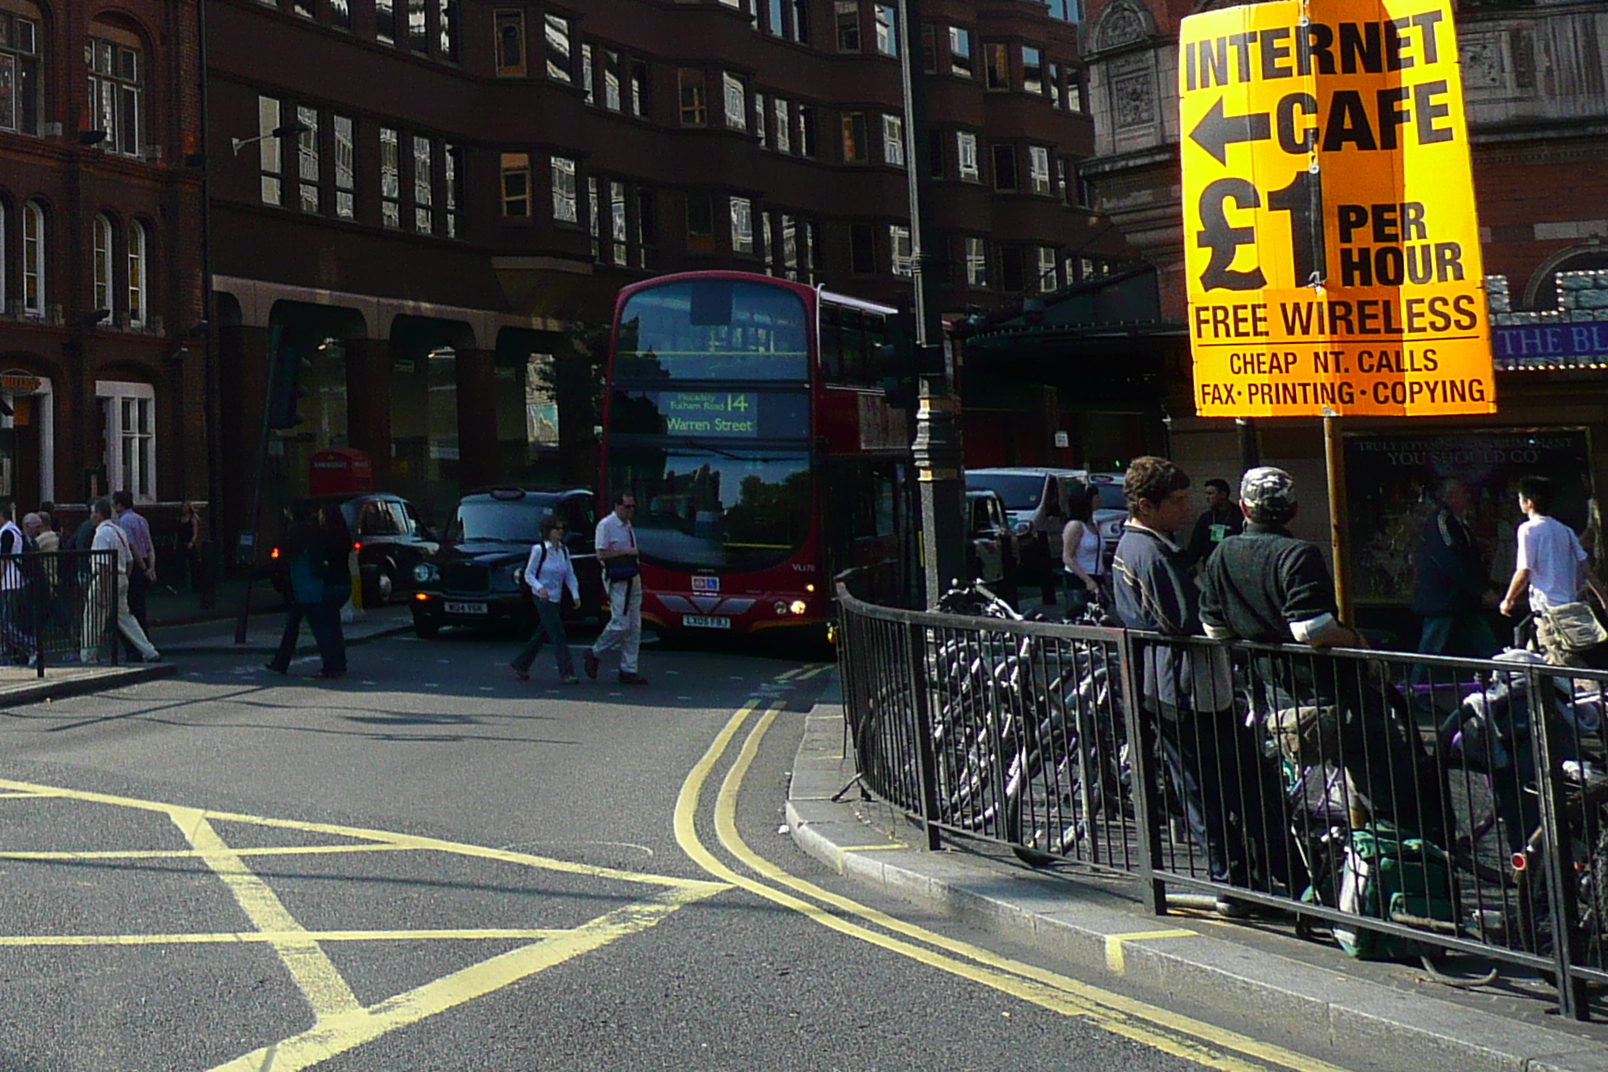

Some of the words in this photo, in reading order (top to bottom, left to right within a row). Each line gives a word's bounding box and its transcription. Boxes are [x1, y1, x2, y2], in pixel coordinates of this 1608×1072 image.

[1185, 9, 1444, 92] INTERNET
[1276, 79, 1454, 155] CAFE
[1196, 170, 1328, 292] £1
[1337, 201, 1428, 244] PER
[1340, 241, 1465, 288] HOUR
[1195, 302, 1270, 339] FREE
[1280, 294, 1478, 337] WIRELESS
[1497, 328, 1564, 355] THE
[1229, 351, 1298, 375] CHEAP
[1357, 348, 1439, 374] CALLS
[727, 393, 749, 412] 14
[1247, 381, 1355, 406] PRINTING
[1372, 378, 1486, 405] COPYING
[667, 417, 711, 432] Warren
[714, 418, 754, 432] Street
[1387, 451, 1426, 466] YOU
[1432, 449, 1506, 466] SHOULD
